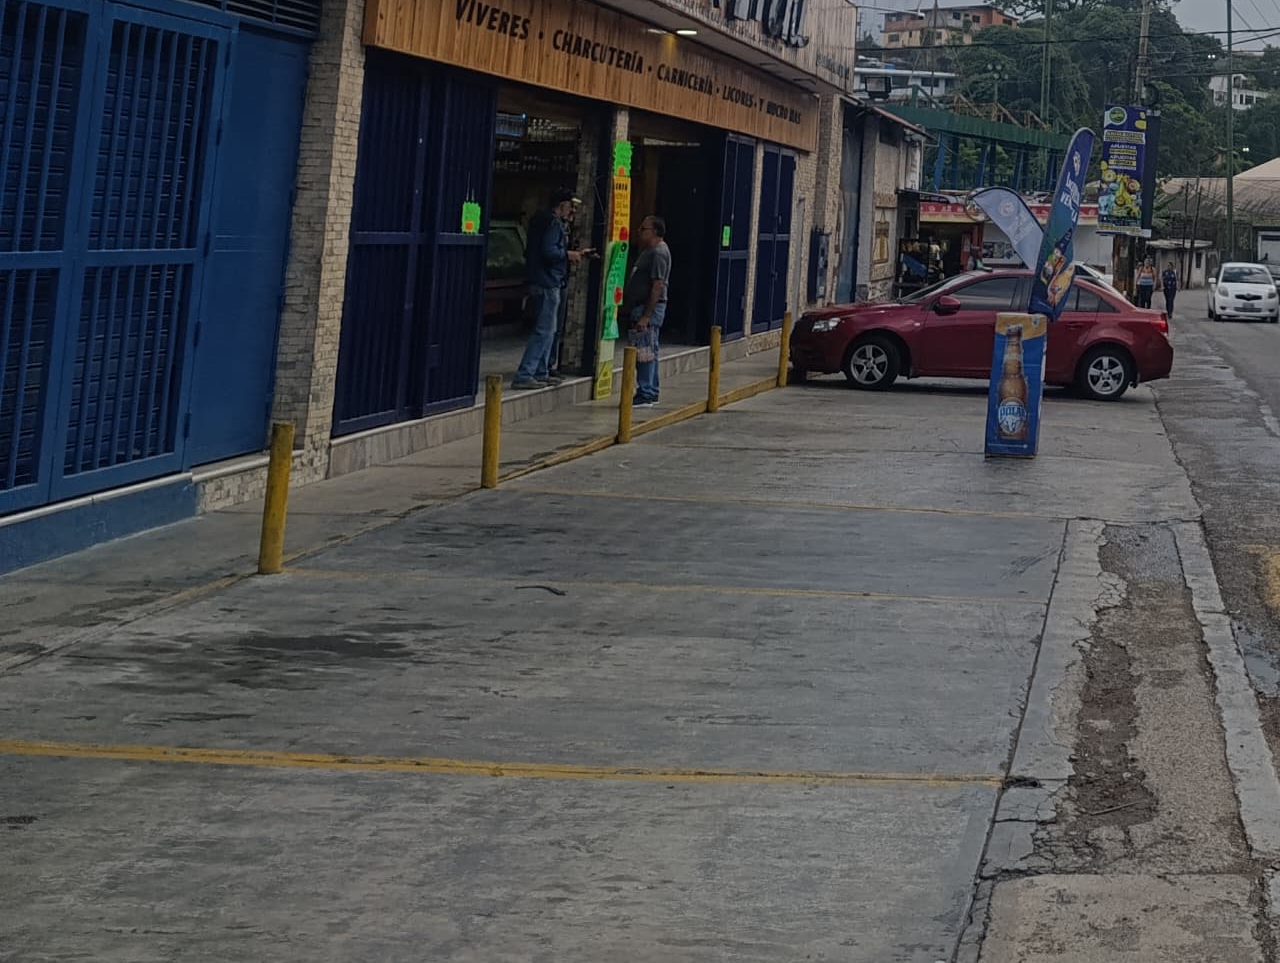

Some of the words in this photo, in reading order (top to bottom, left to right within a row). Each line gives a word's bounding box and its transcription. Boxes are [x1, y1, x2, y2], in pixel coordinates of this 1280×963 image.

[552, 29, 644, 75] CHARCUTERÍA
[656, 63, 713, 96] CARNICERÍA
[722, 84, 754, 108] LICORES
